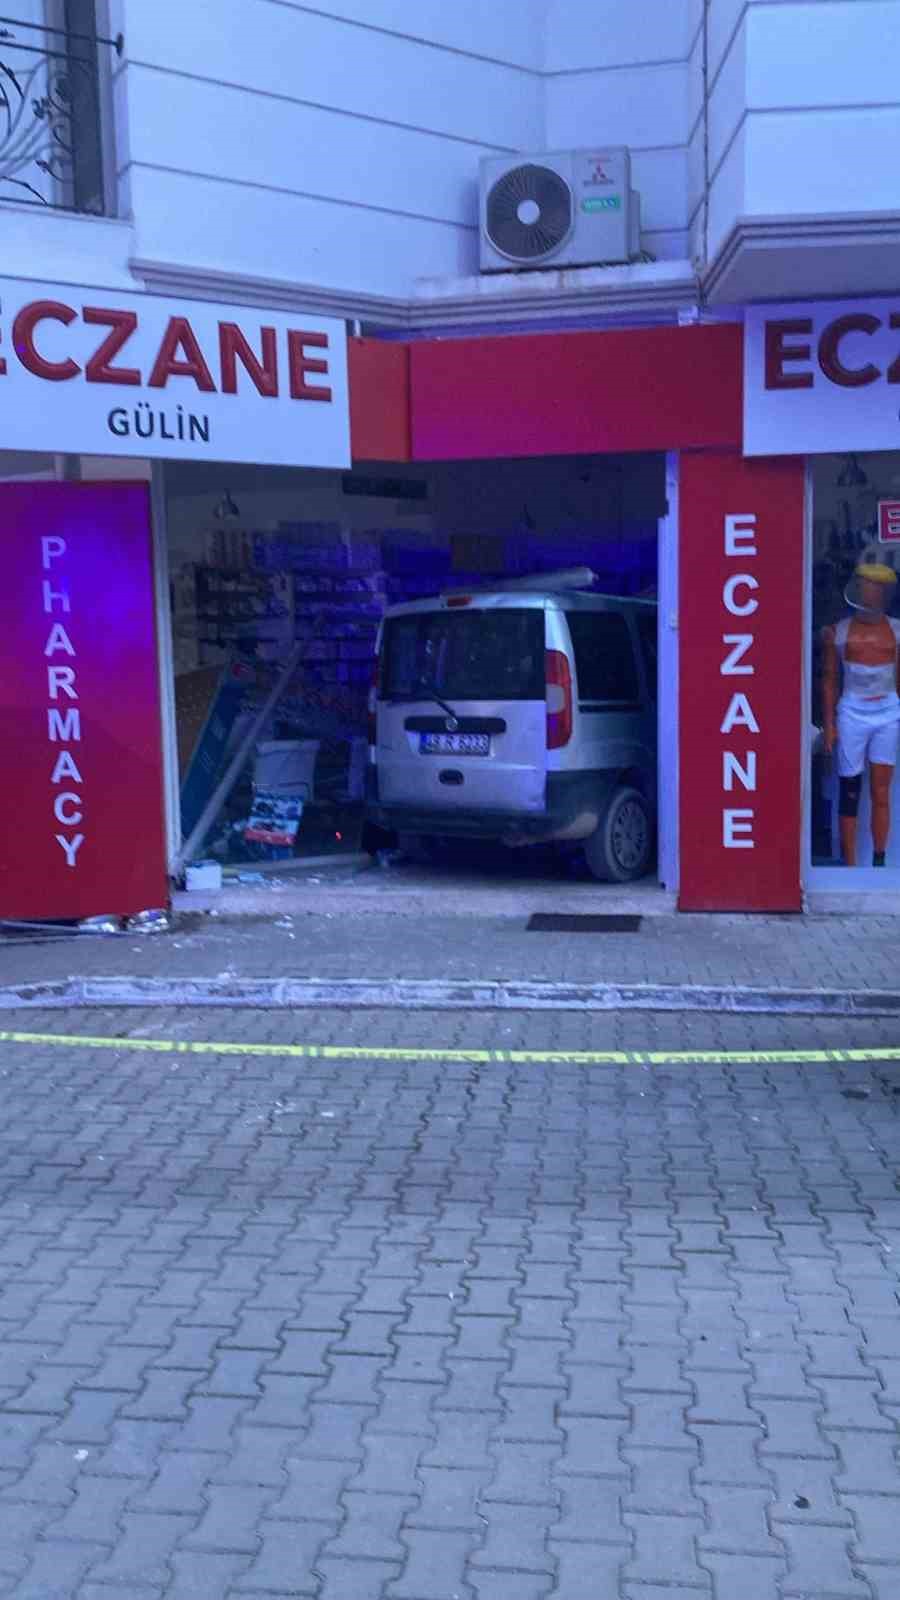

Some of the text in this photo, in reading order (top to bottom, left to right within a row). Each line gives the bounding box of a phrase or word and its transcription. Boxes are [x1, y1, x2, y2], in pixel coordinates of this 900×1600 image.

[0, 299, 333, 403] CZANE
[764, 312, 900, 389] EC
[41, 536, 84, 867] PHARMACY
[720, 513, 760, 849] ECZANE
